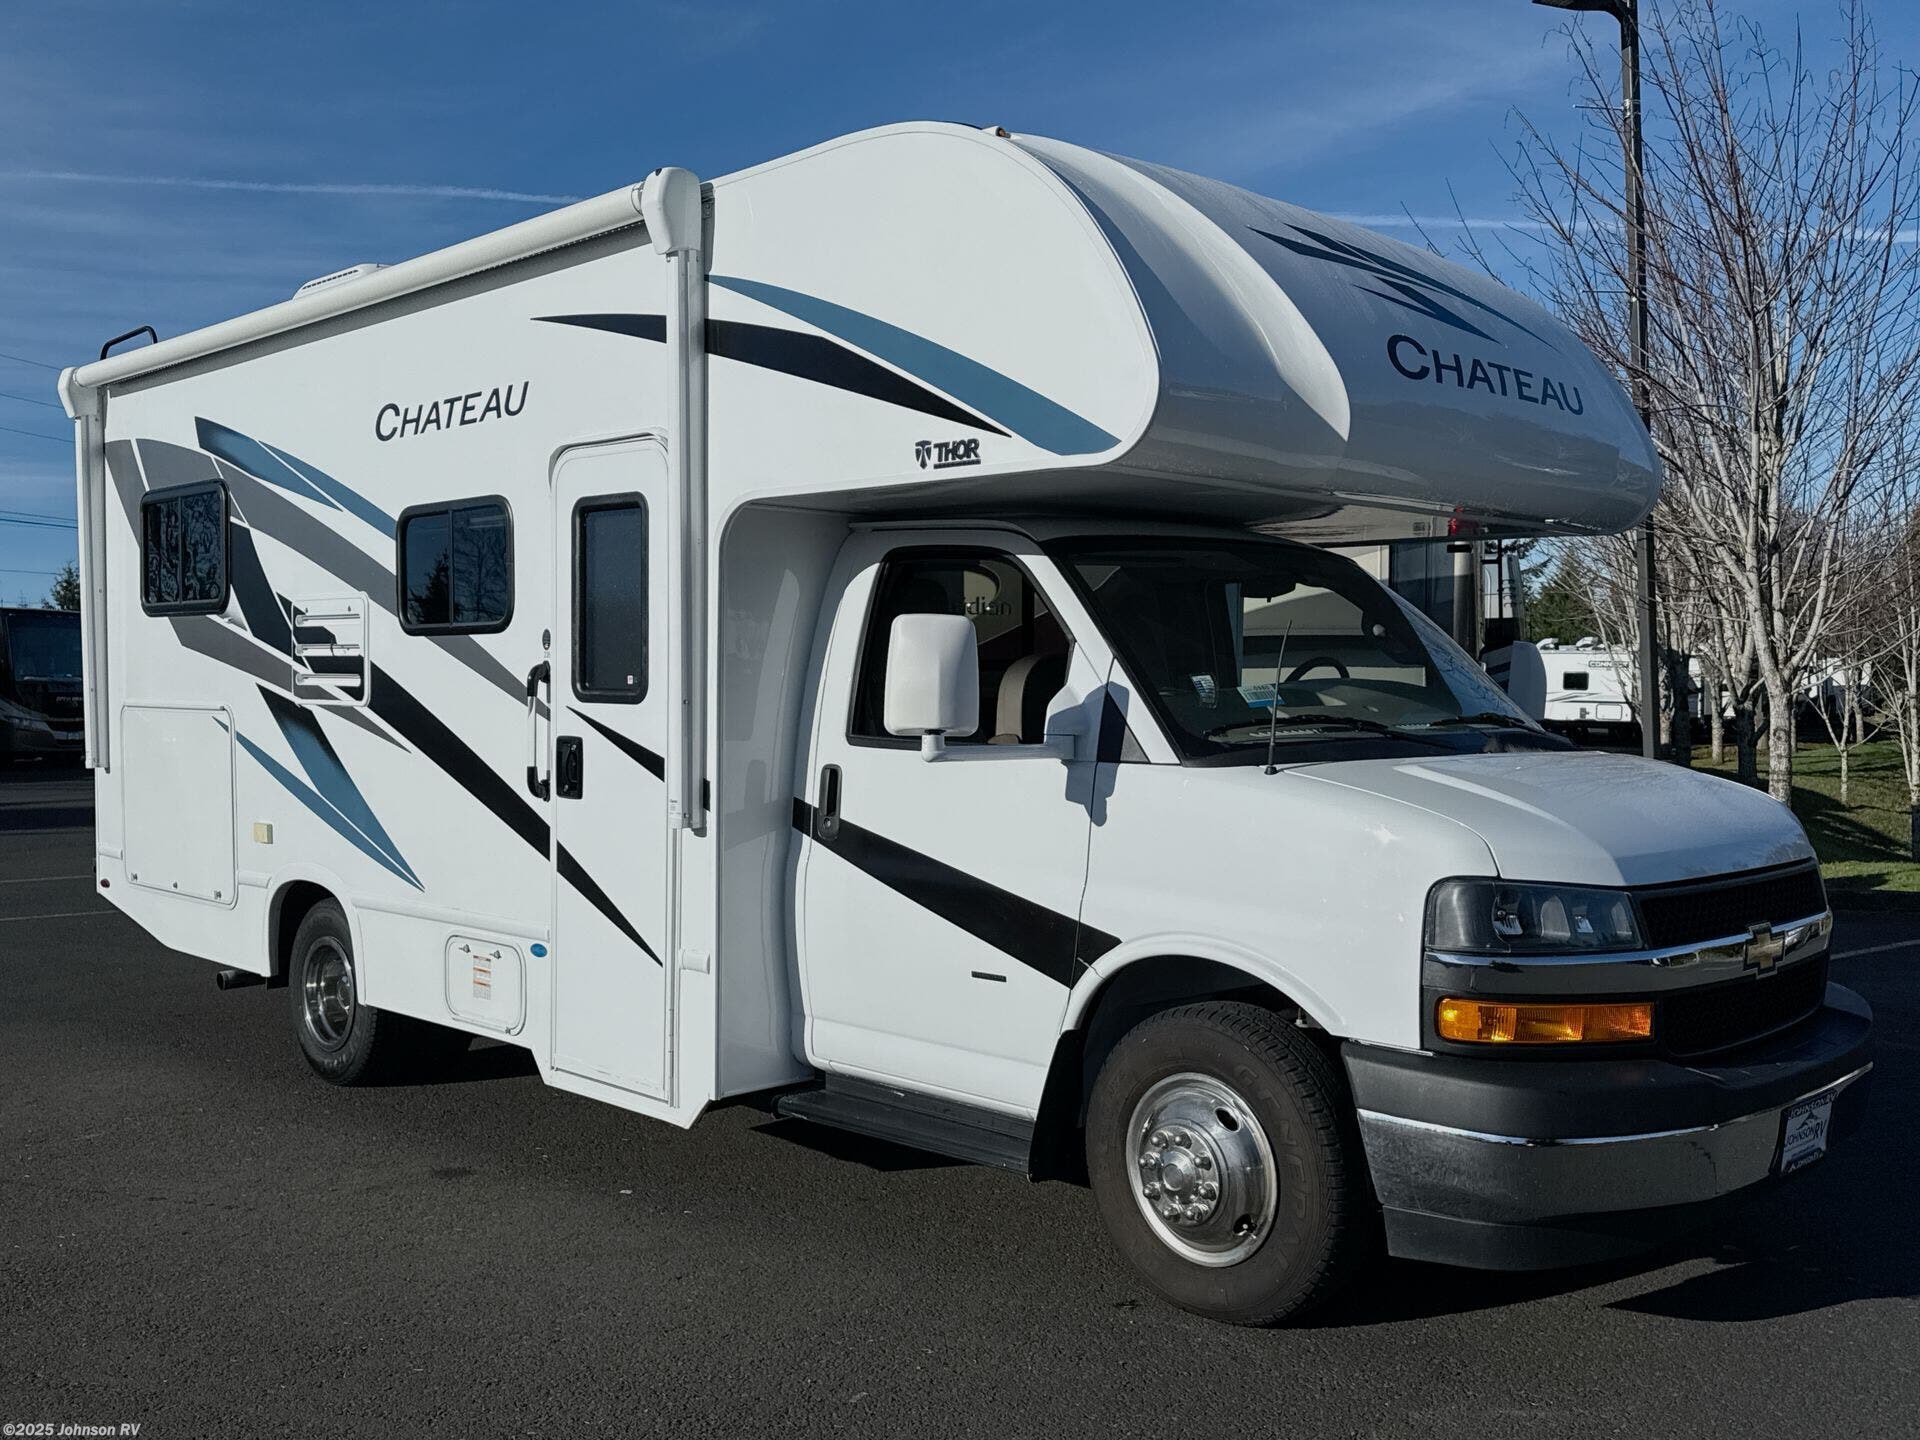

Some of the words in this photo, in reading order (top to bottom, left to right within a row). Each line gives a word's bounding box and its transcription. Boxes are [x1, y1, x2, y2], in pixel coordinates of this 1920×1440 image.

[1386, 333, 1584, 416] CHATEAU
[375, 380, 530, 442] CHATEAU
[933, 438, 981, 462] THOR
